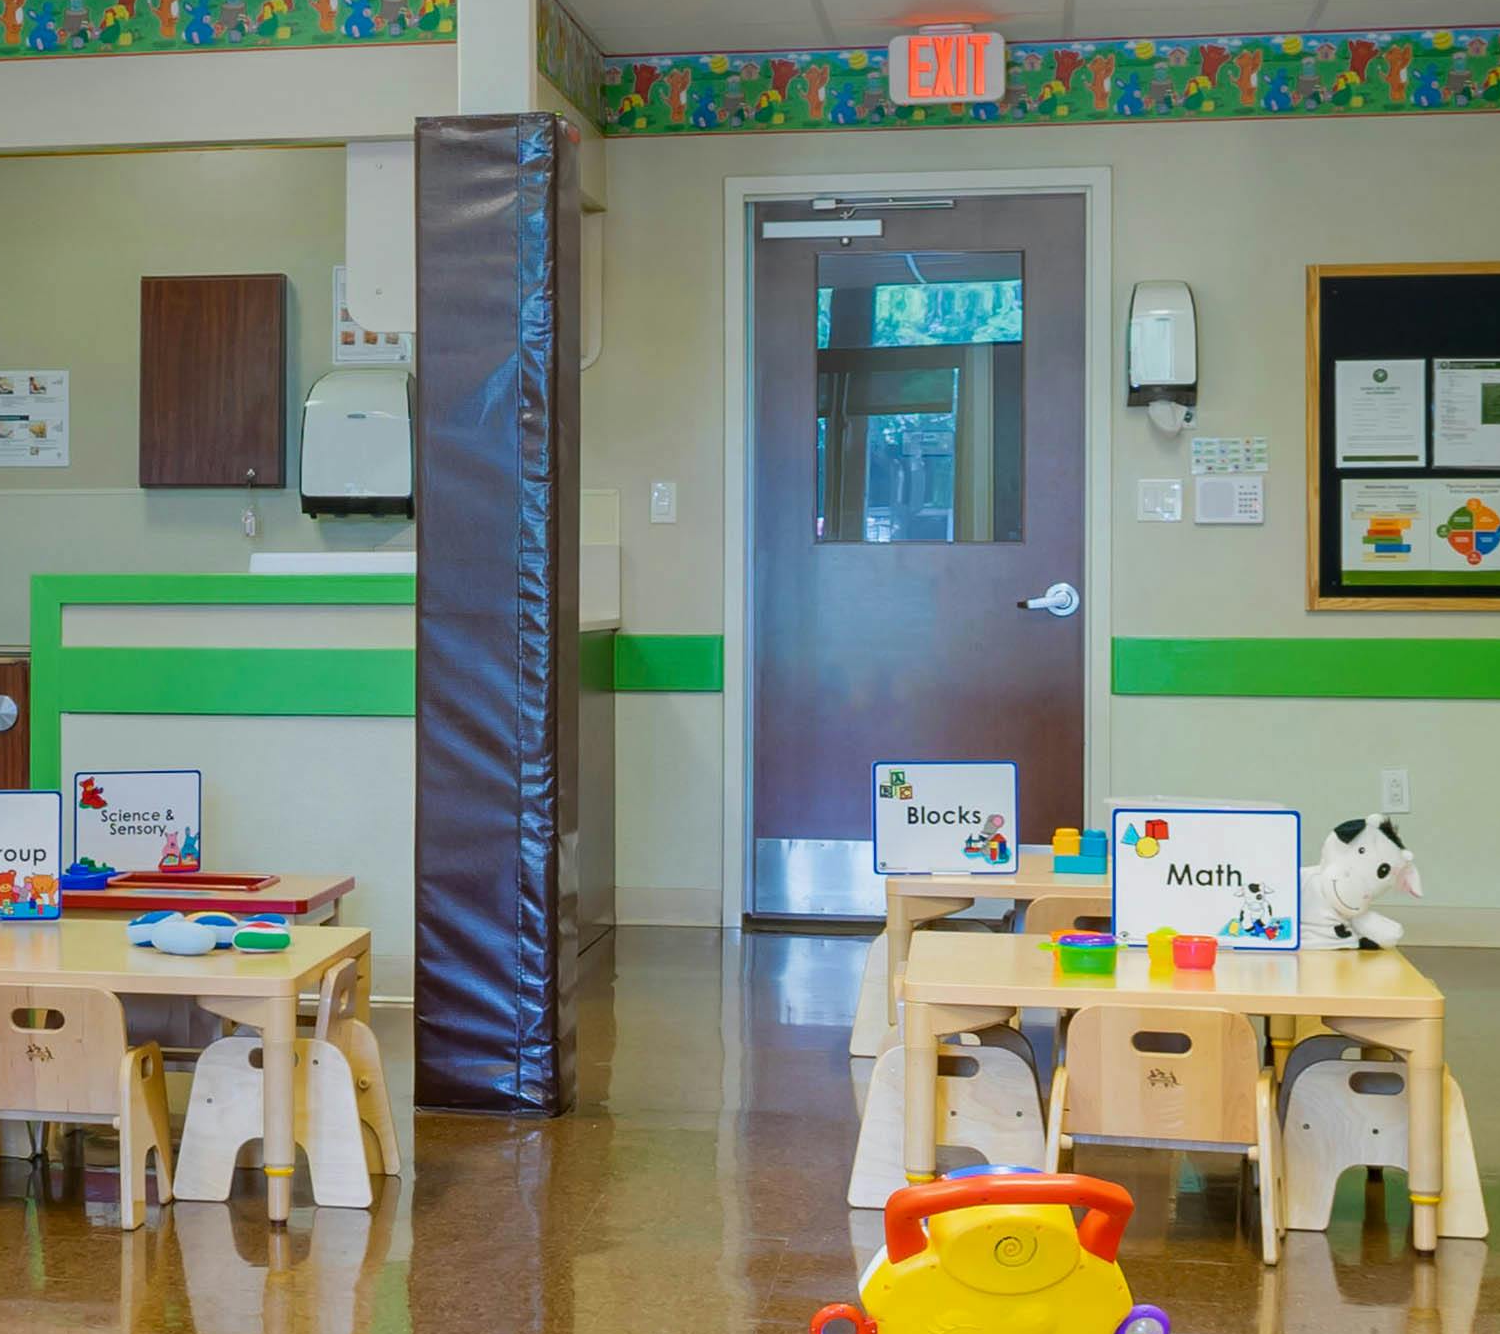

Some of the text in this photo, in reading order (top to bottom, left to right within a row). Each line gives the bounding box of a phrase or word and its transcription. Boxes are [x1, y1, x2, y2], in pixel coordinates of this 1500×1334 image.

[908, 34, 992, 98] EXIT
[100, 808, 176, 824] Science &
[906, 804, 982, 827] Blocks
[109, 822, 167, 838] Sensory
[1166, 862, 1244, 888] Math
